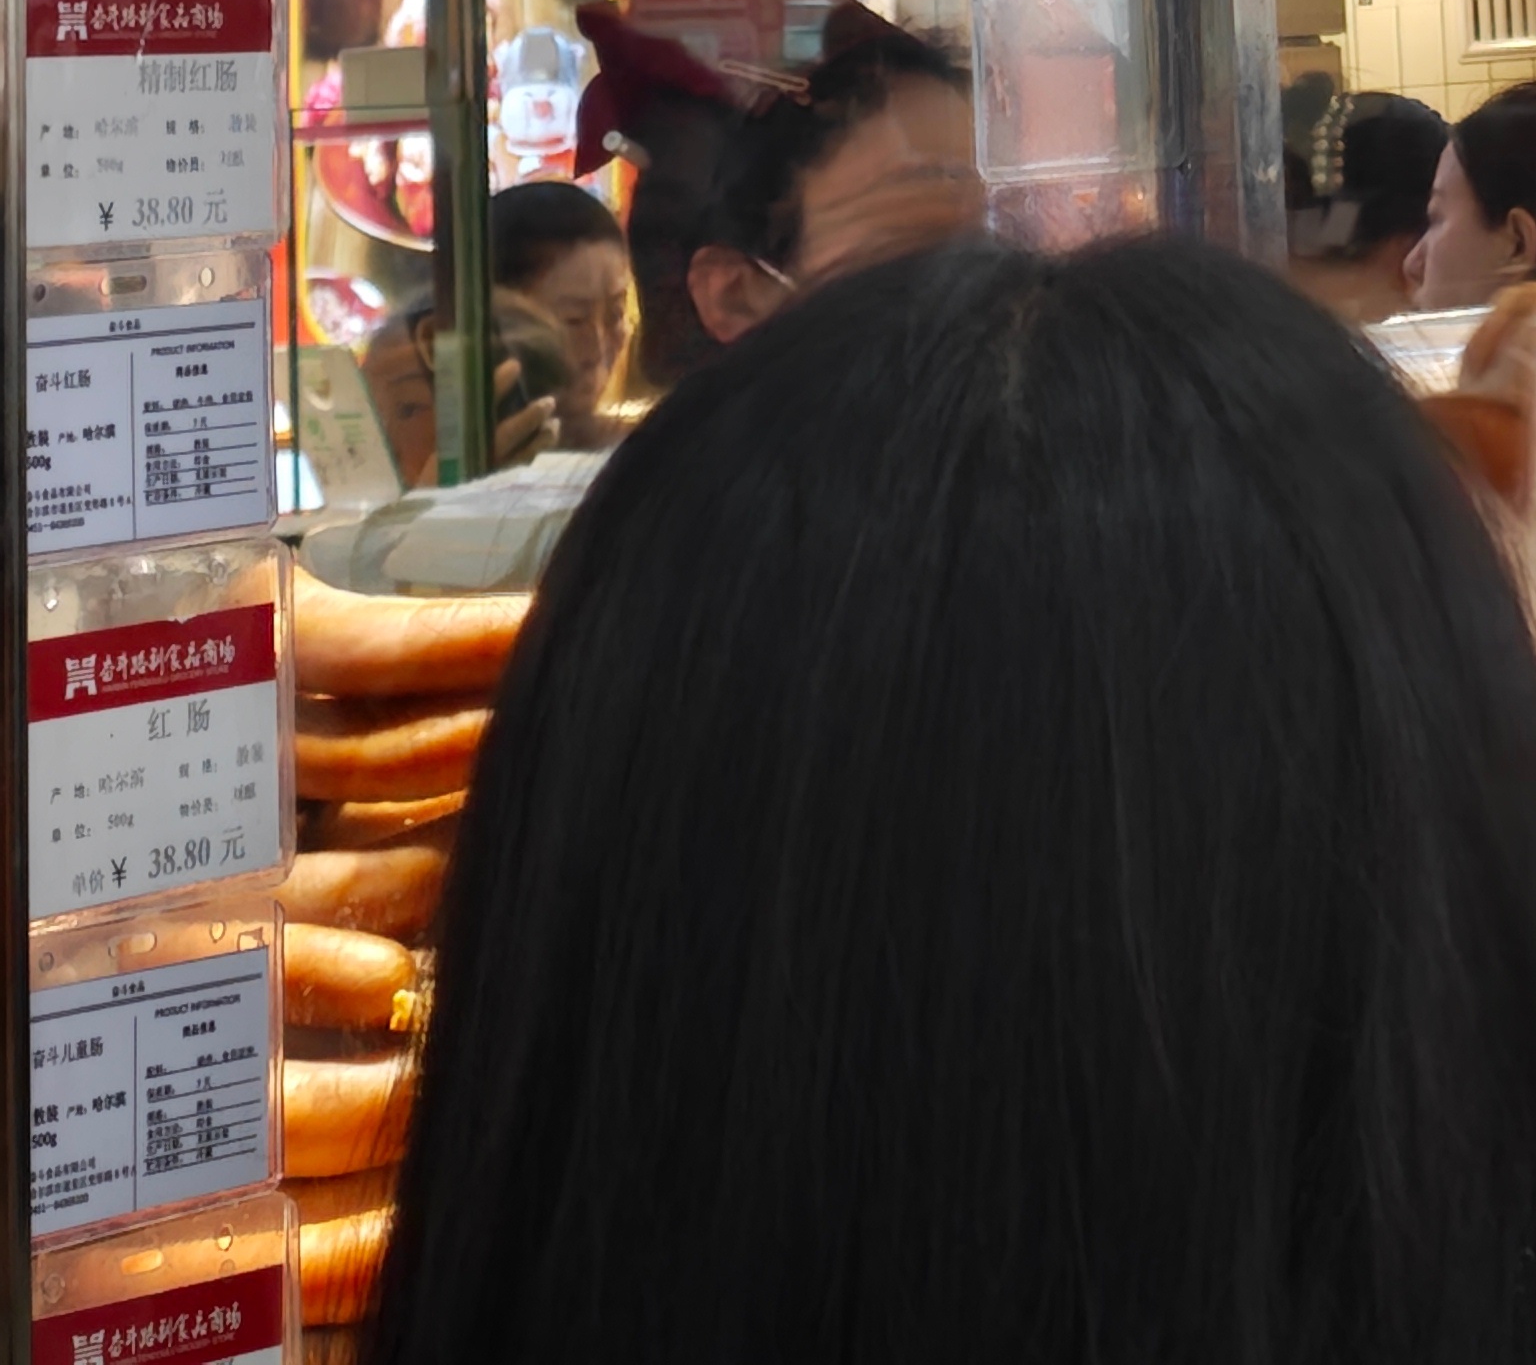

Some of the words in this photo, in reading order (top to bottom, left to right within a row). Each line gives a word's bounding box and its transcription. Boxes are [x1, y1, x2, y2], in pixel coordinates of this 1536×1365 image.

[138, 59, 238, 95] 精制红肠
[131, 195, 194, 228] 38.80
[202, 188, 229, 226] 元
[35, 368, 92, 393] 奋斗红肠
[147, 698, 212, 741] 红肠
[148, 835, 212, 880] 38.80
[220, 825, 246, 867] 元
[32, 1036, 104, 1070] 奋斗儿童肠
